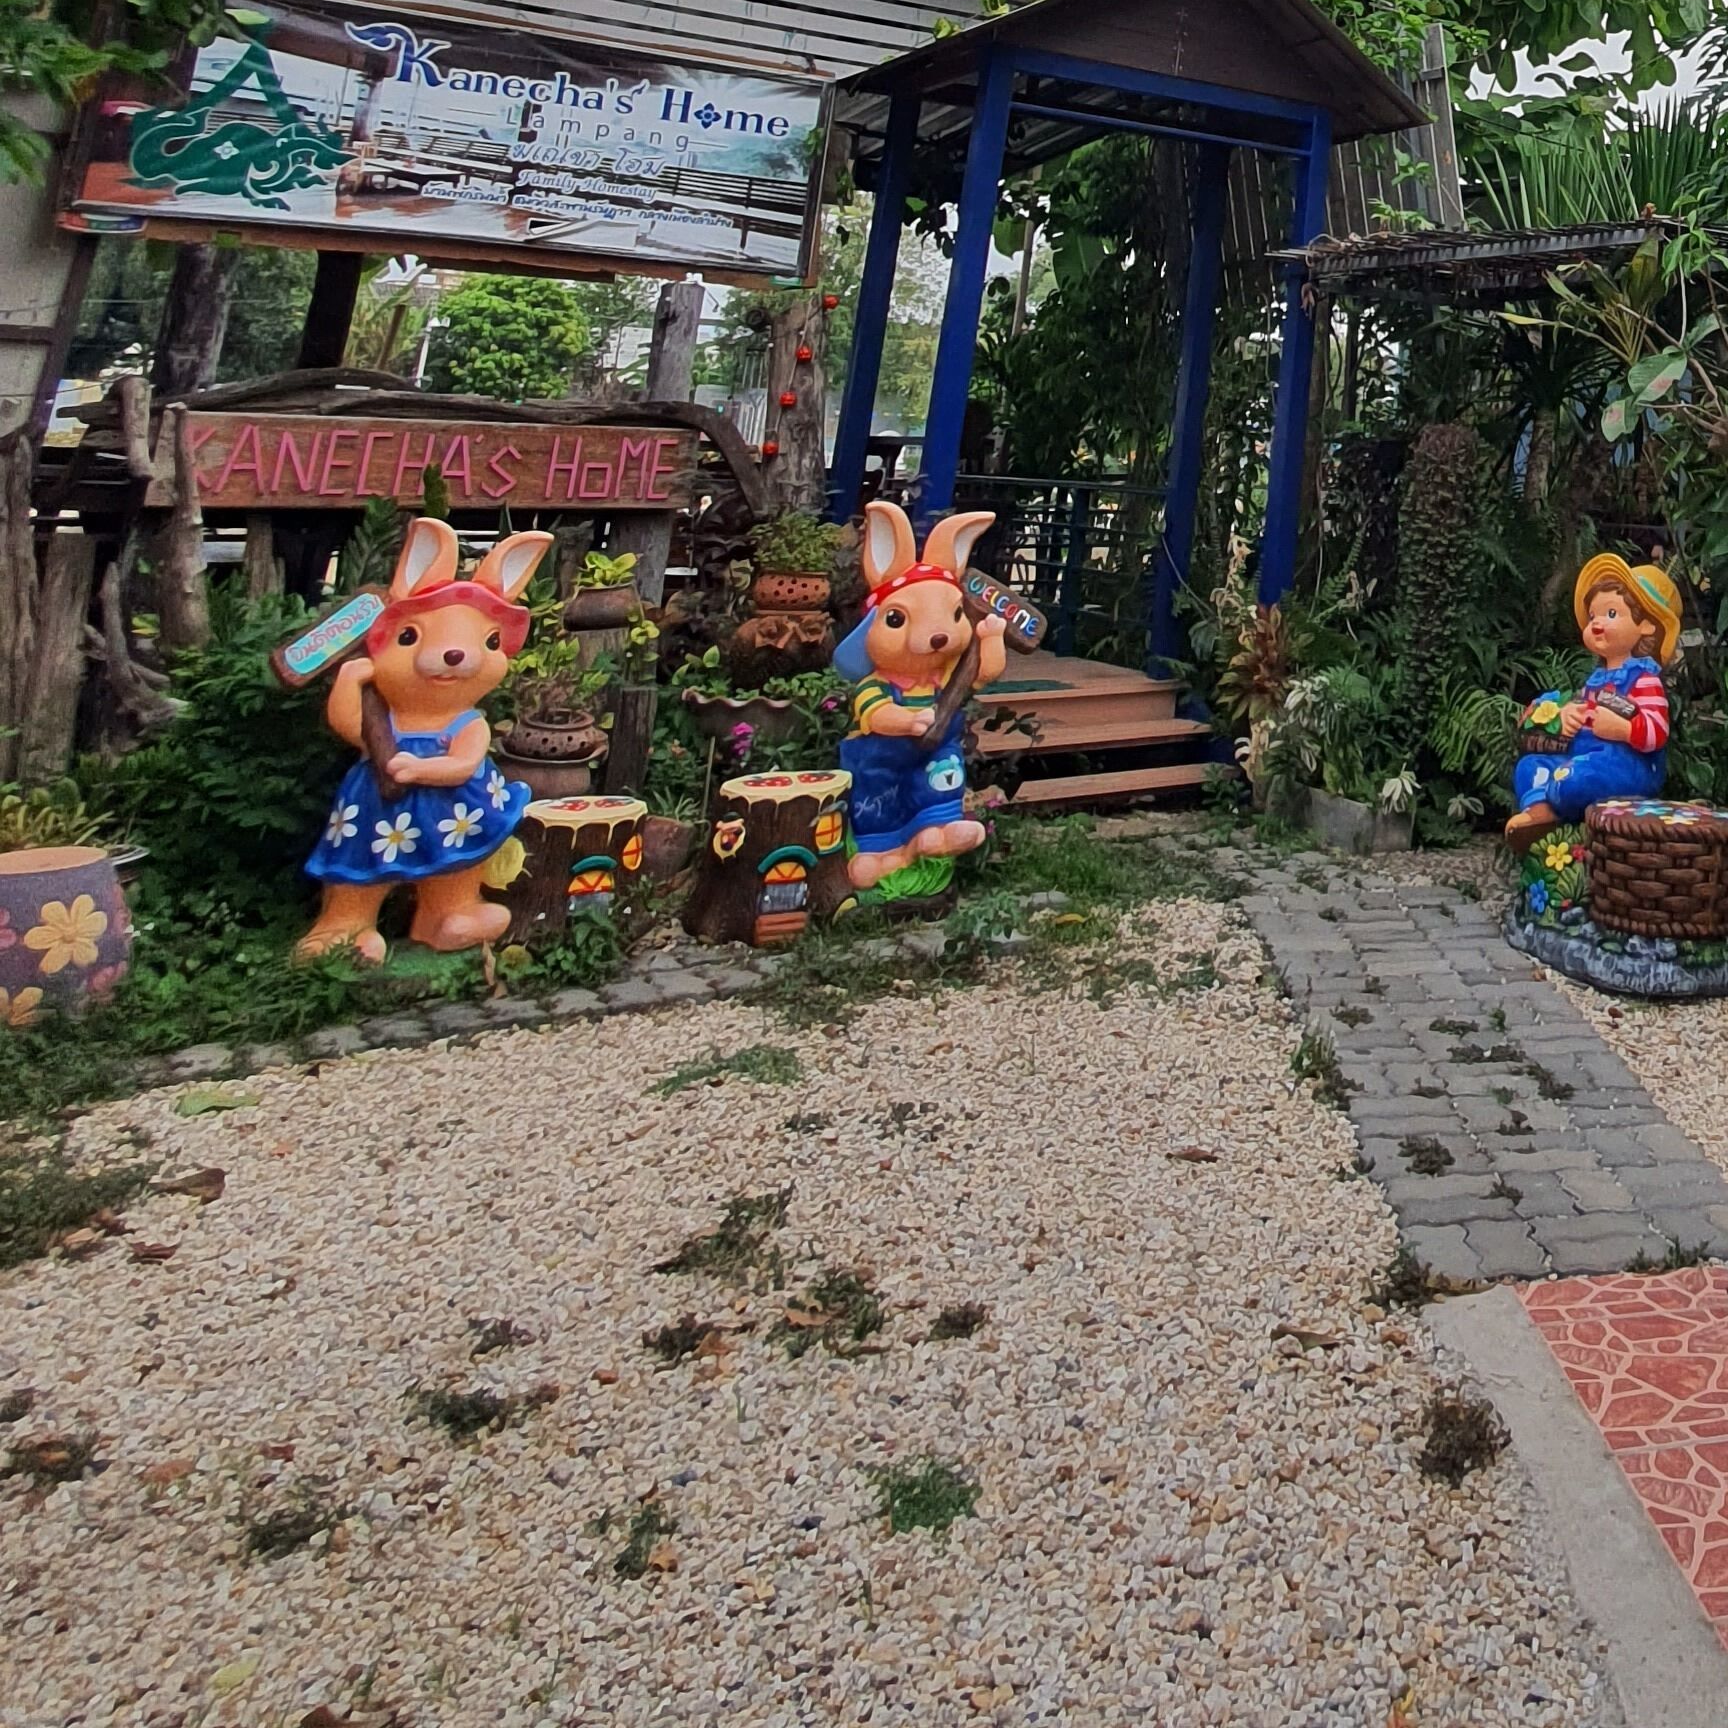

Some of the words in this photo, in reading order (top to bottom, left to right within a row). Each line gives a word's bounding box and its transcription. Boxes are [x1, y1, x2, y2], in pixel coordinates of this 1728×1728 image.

[344, 21, 648, 115] Kanecha's
[506, 108, 690, 153] Lampang
[517, 170, 577, 194] Family
[583, 177, 656, 201] Homestay
[968, 575, 1040, 637] WELCOME
